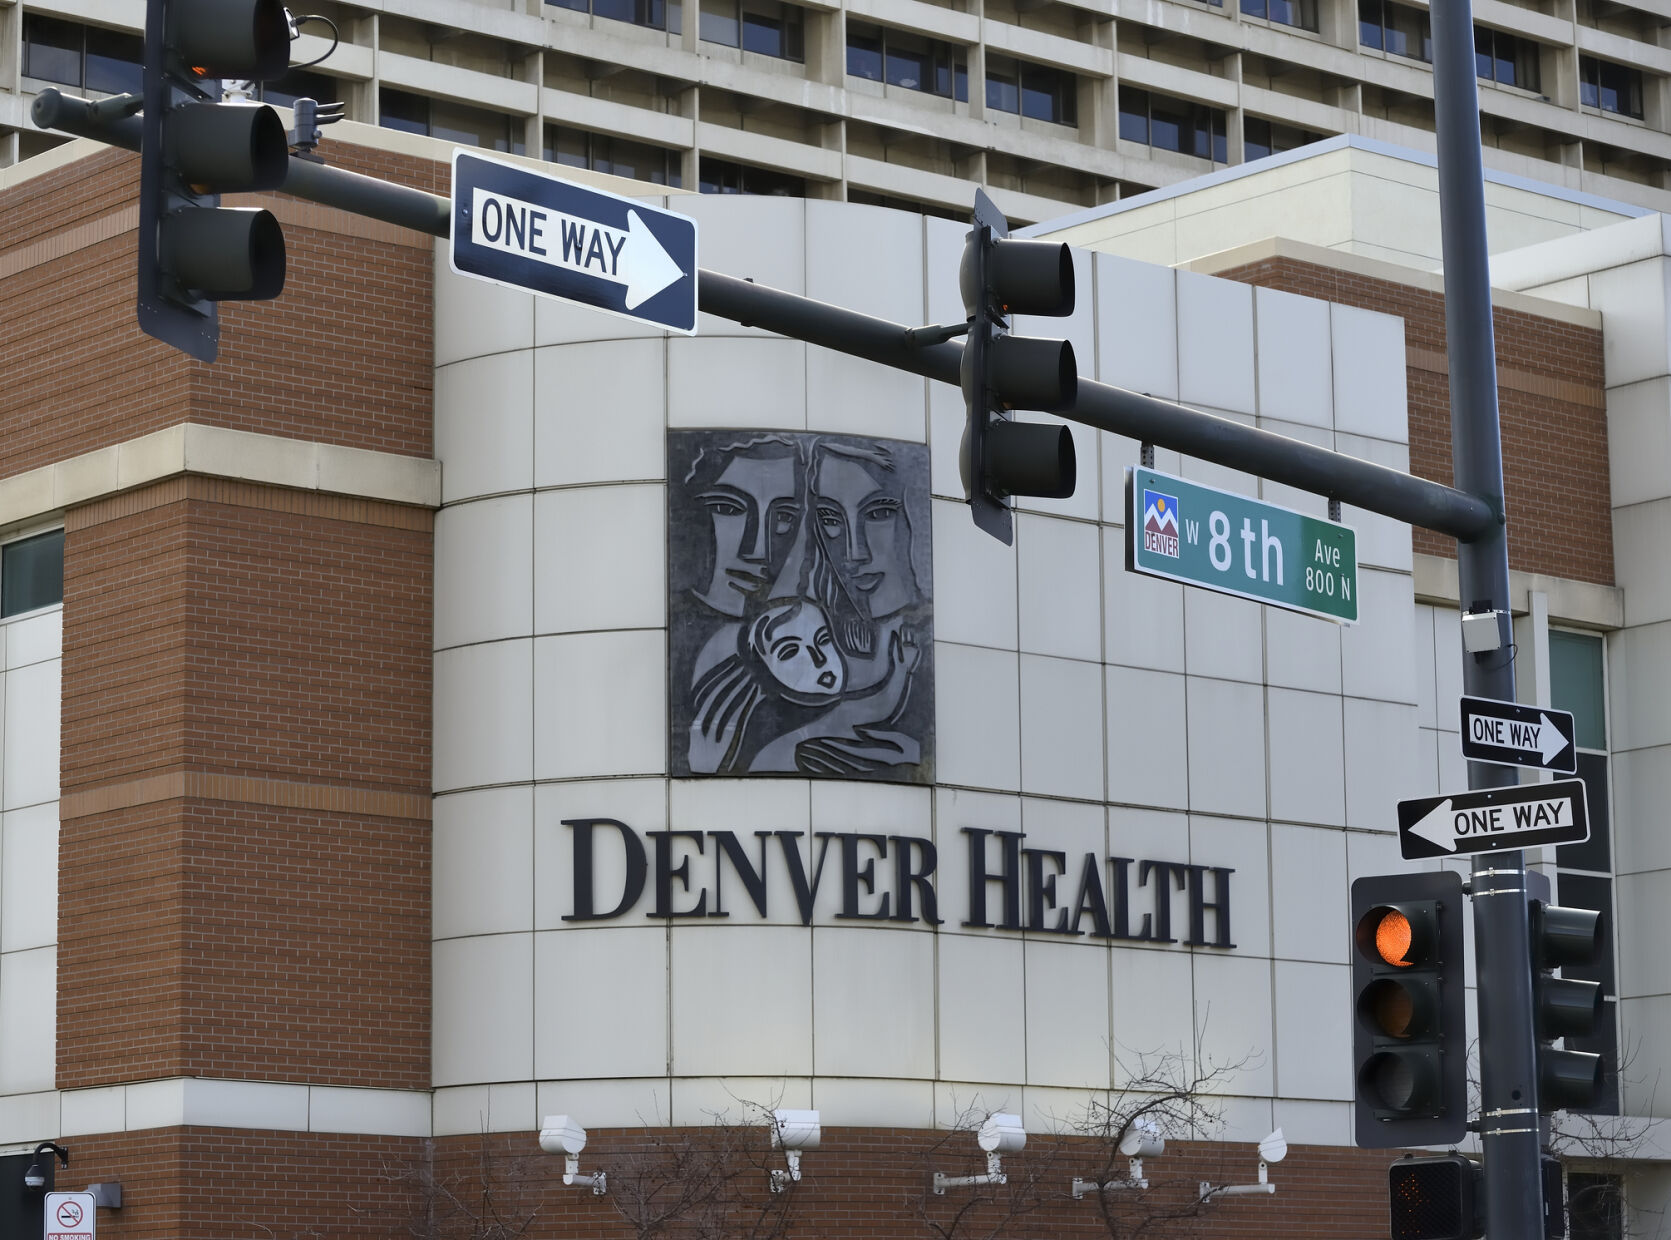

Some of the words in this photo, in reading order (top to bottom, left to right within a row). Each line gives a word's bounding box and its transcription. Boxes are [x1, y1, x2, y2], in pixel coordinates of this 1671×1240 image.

[482, 197, 547, 256] ONE
[561, 218, 627, 276] WAY
[1145, 531, 1179, 558] DENVER
[1185, 518, 1199, 545] W
[1209, 510, 1284, 586] 8th
[1315, 538, 1340, 567] Ave
[1306, 566, 1334, 596] 800
[1341, 577, 1350, 600] N
[1473, 717, 1504, 744] ONE
[1510, 722, 1540, 748] WAY
[1454, 808, 1504, 835] ONE
[1513, 801, 1564, 828] WAY
[561, 818, 944, 927] DENVER
[962, 827, 1236, 949] HEALTH
